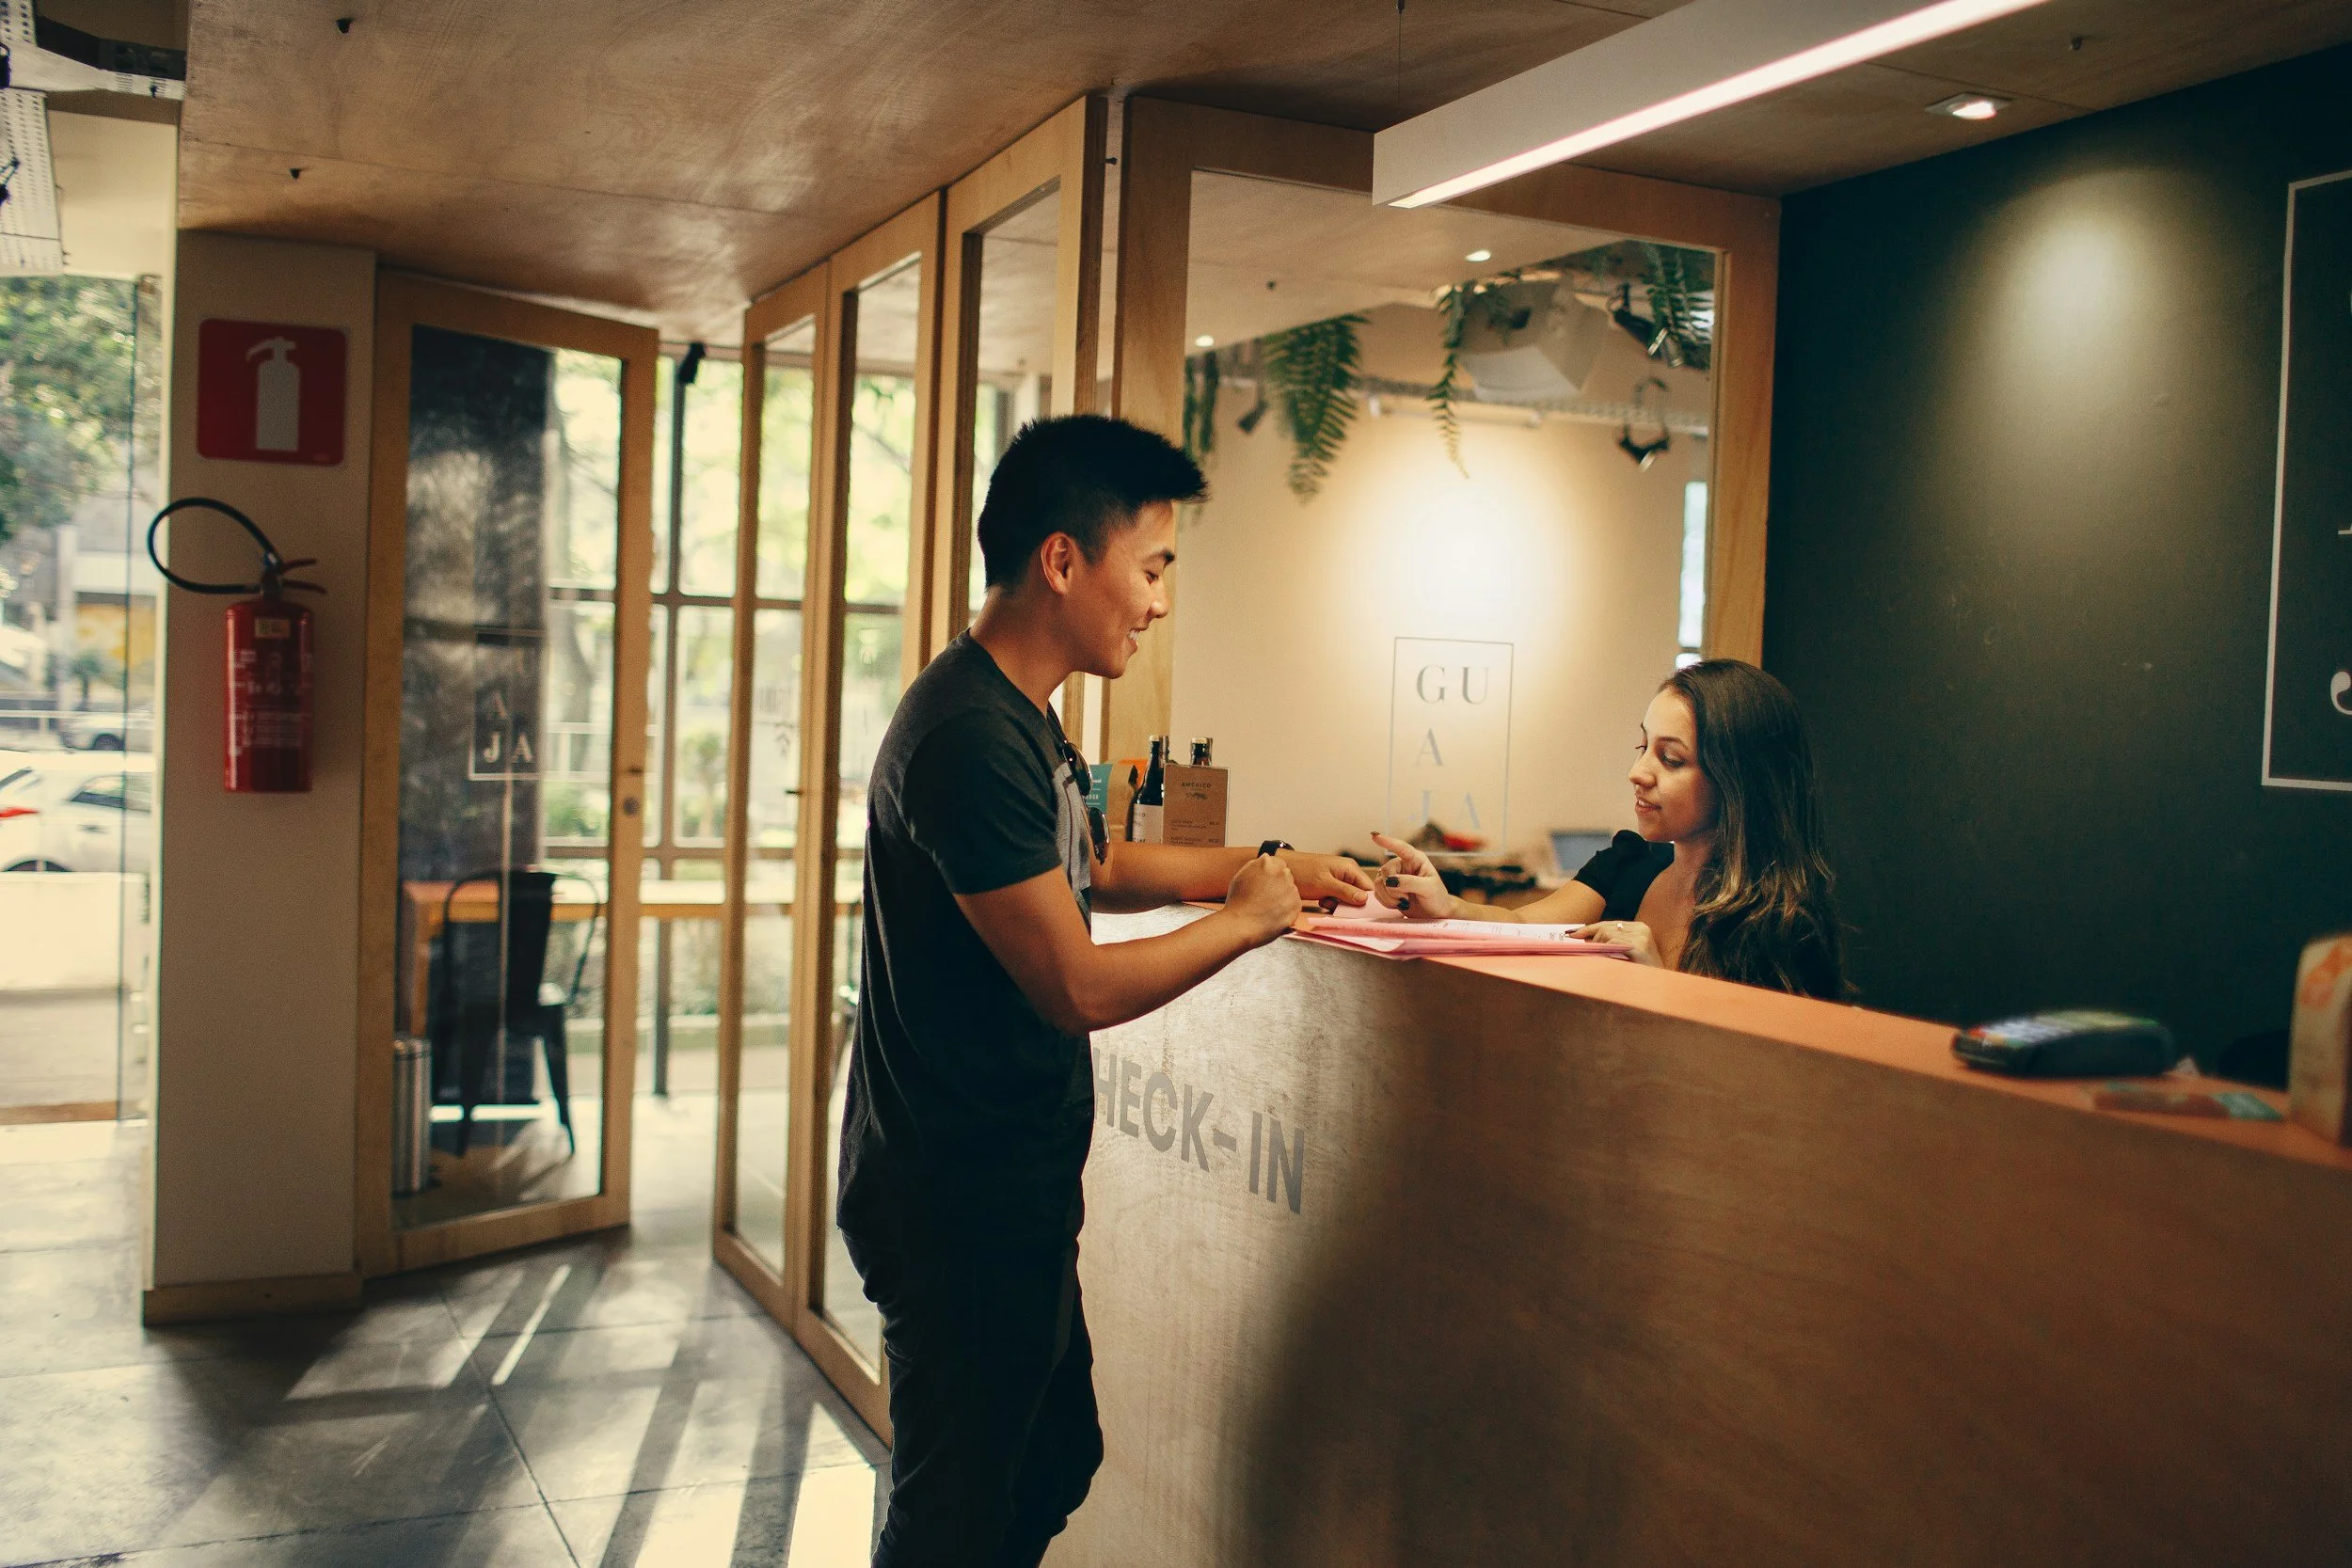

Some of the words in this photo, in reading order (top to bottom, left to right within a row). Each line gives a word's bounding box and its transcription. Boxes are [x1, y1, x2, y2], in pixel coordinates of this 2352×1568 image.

[1416, 664, 1490, 705] GU
[482, 730, 533, 764] JA
[1416, 728, 1443, 767] A
[1408, 789, 1482, 831] JA
[1092, 1047, 1305, 1215] HECK-IN
